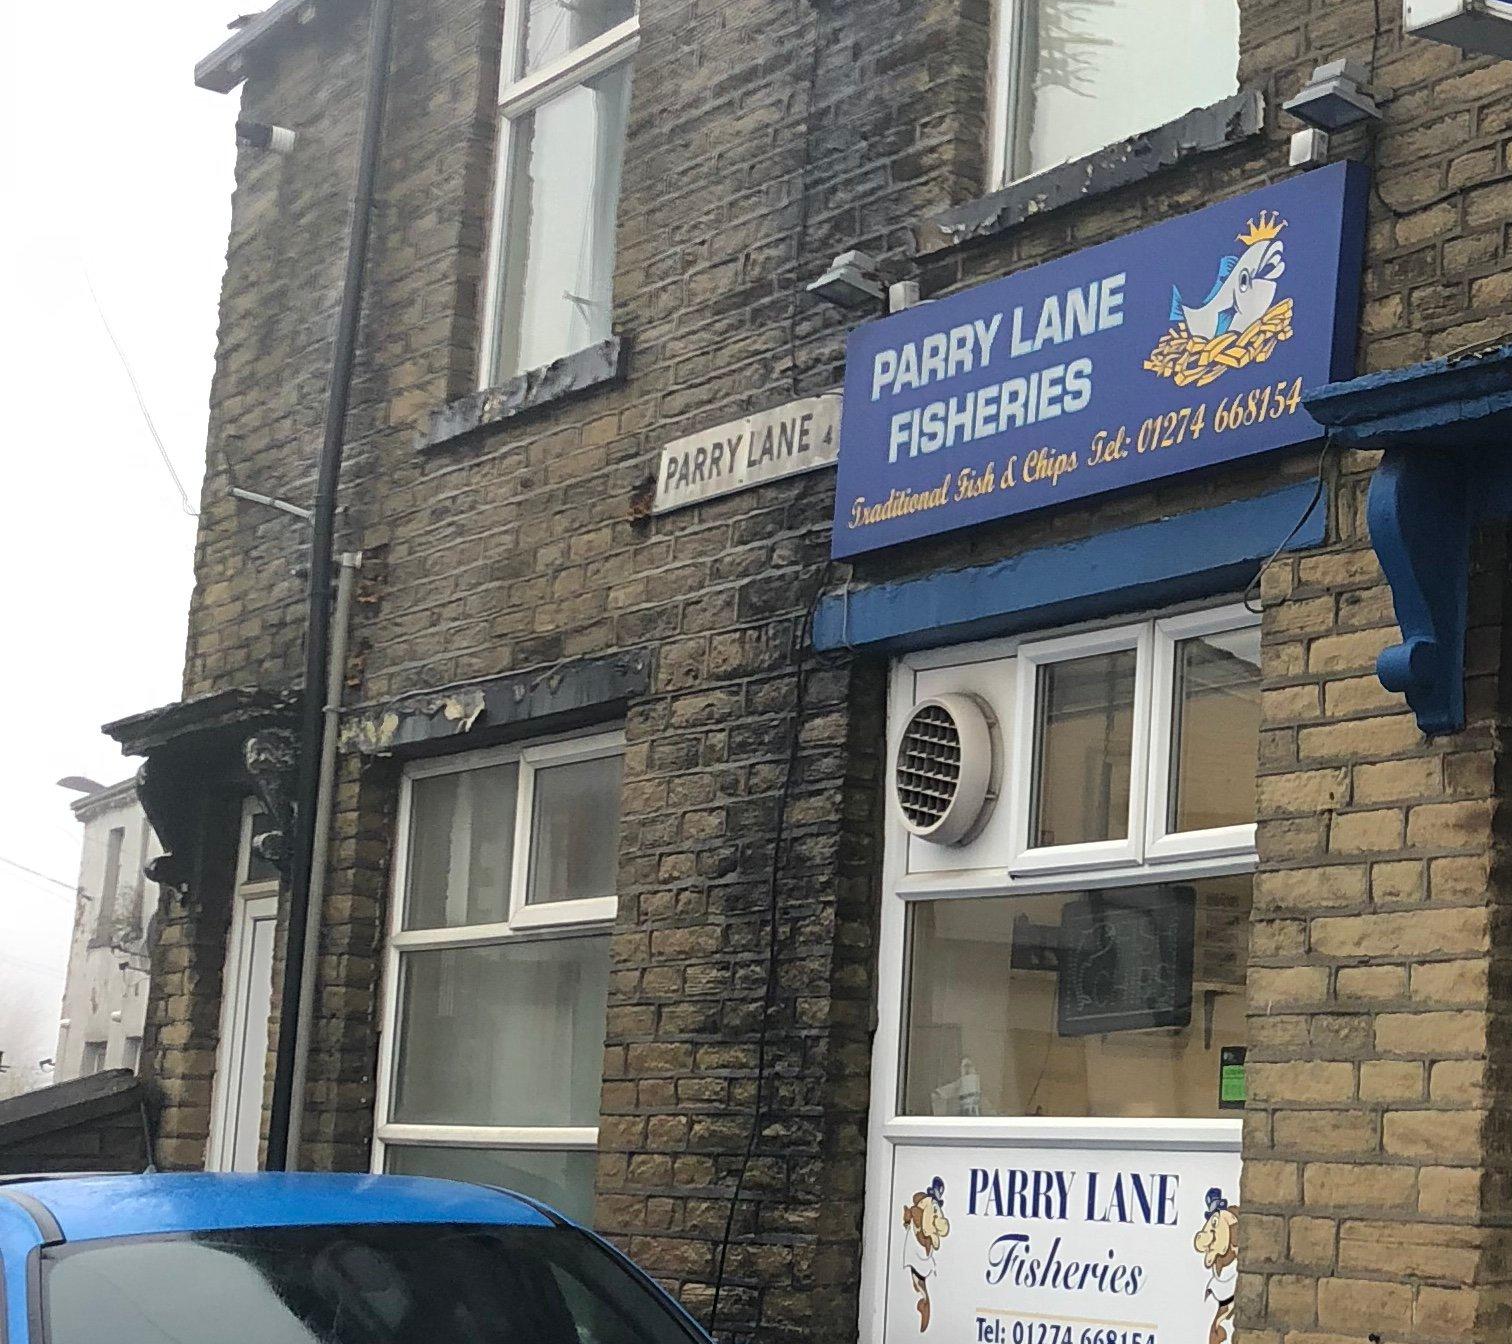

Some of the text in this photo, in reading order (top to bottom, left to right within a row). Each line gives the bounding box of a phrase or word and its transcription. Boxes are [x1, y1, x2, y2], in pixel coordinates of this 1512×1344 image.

[870, 272, 1127, 402] PARRY LANE
[664, 413, 833, 494] PARRY LANE 4
[848, 375, 1303, 530] Traditional Fish & Chips Tel: 01274 668154
[888, 356, 1094, 464] FISHERIES
[966, 1167, 1180, 1227] PARRY LANE
[985, 1232, 1146, 1297] Fisheries
